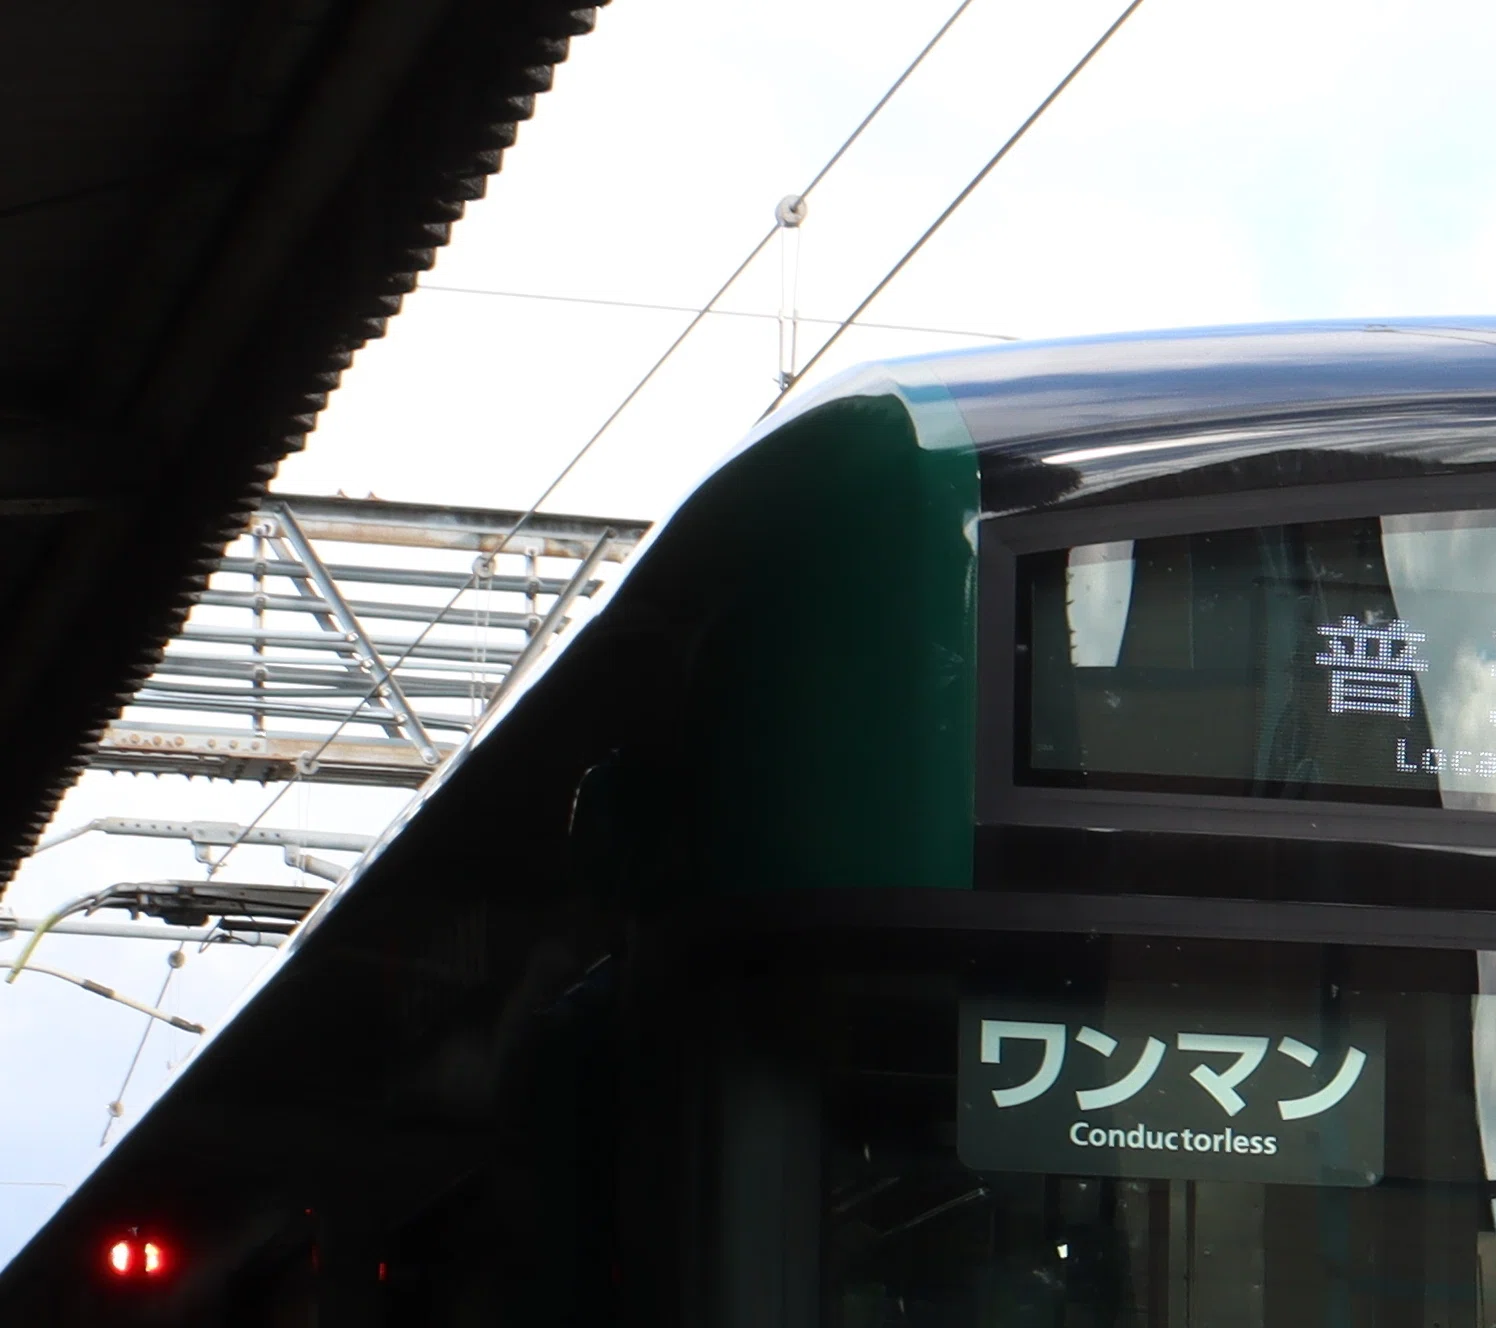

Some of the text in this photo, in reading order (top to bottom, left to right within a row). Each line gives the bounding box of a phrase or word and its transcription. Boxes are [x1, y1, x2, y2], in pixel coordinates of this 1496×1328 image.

[979, 1018, 1367, 1122] ワンマン
[1069, 1120, 1278, 1156] Conductorless
